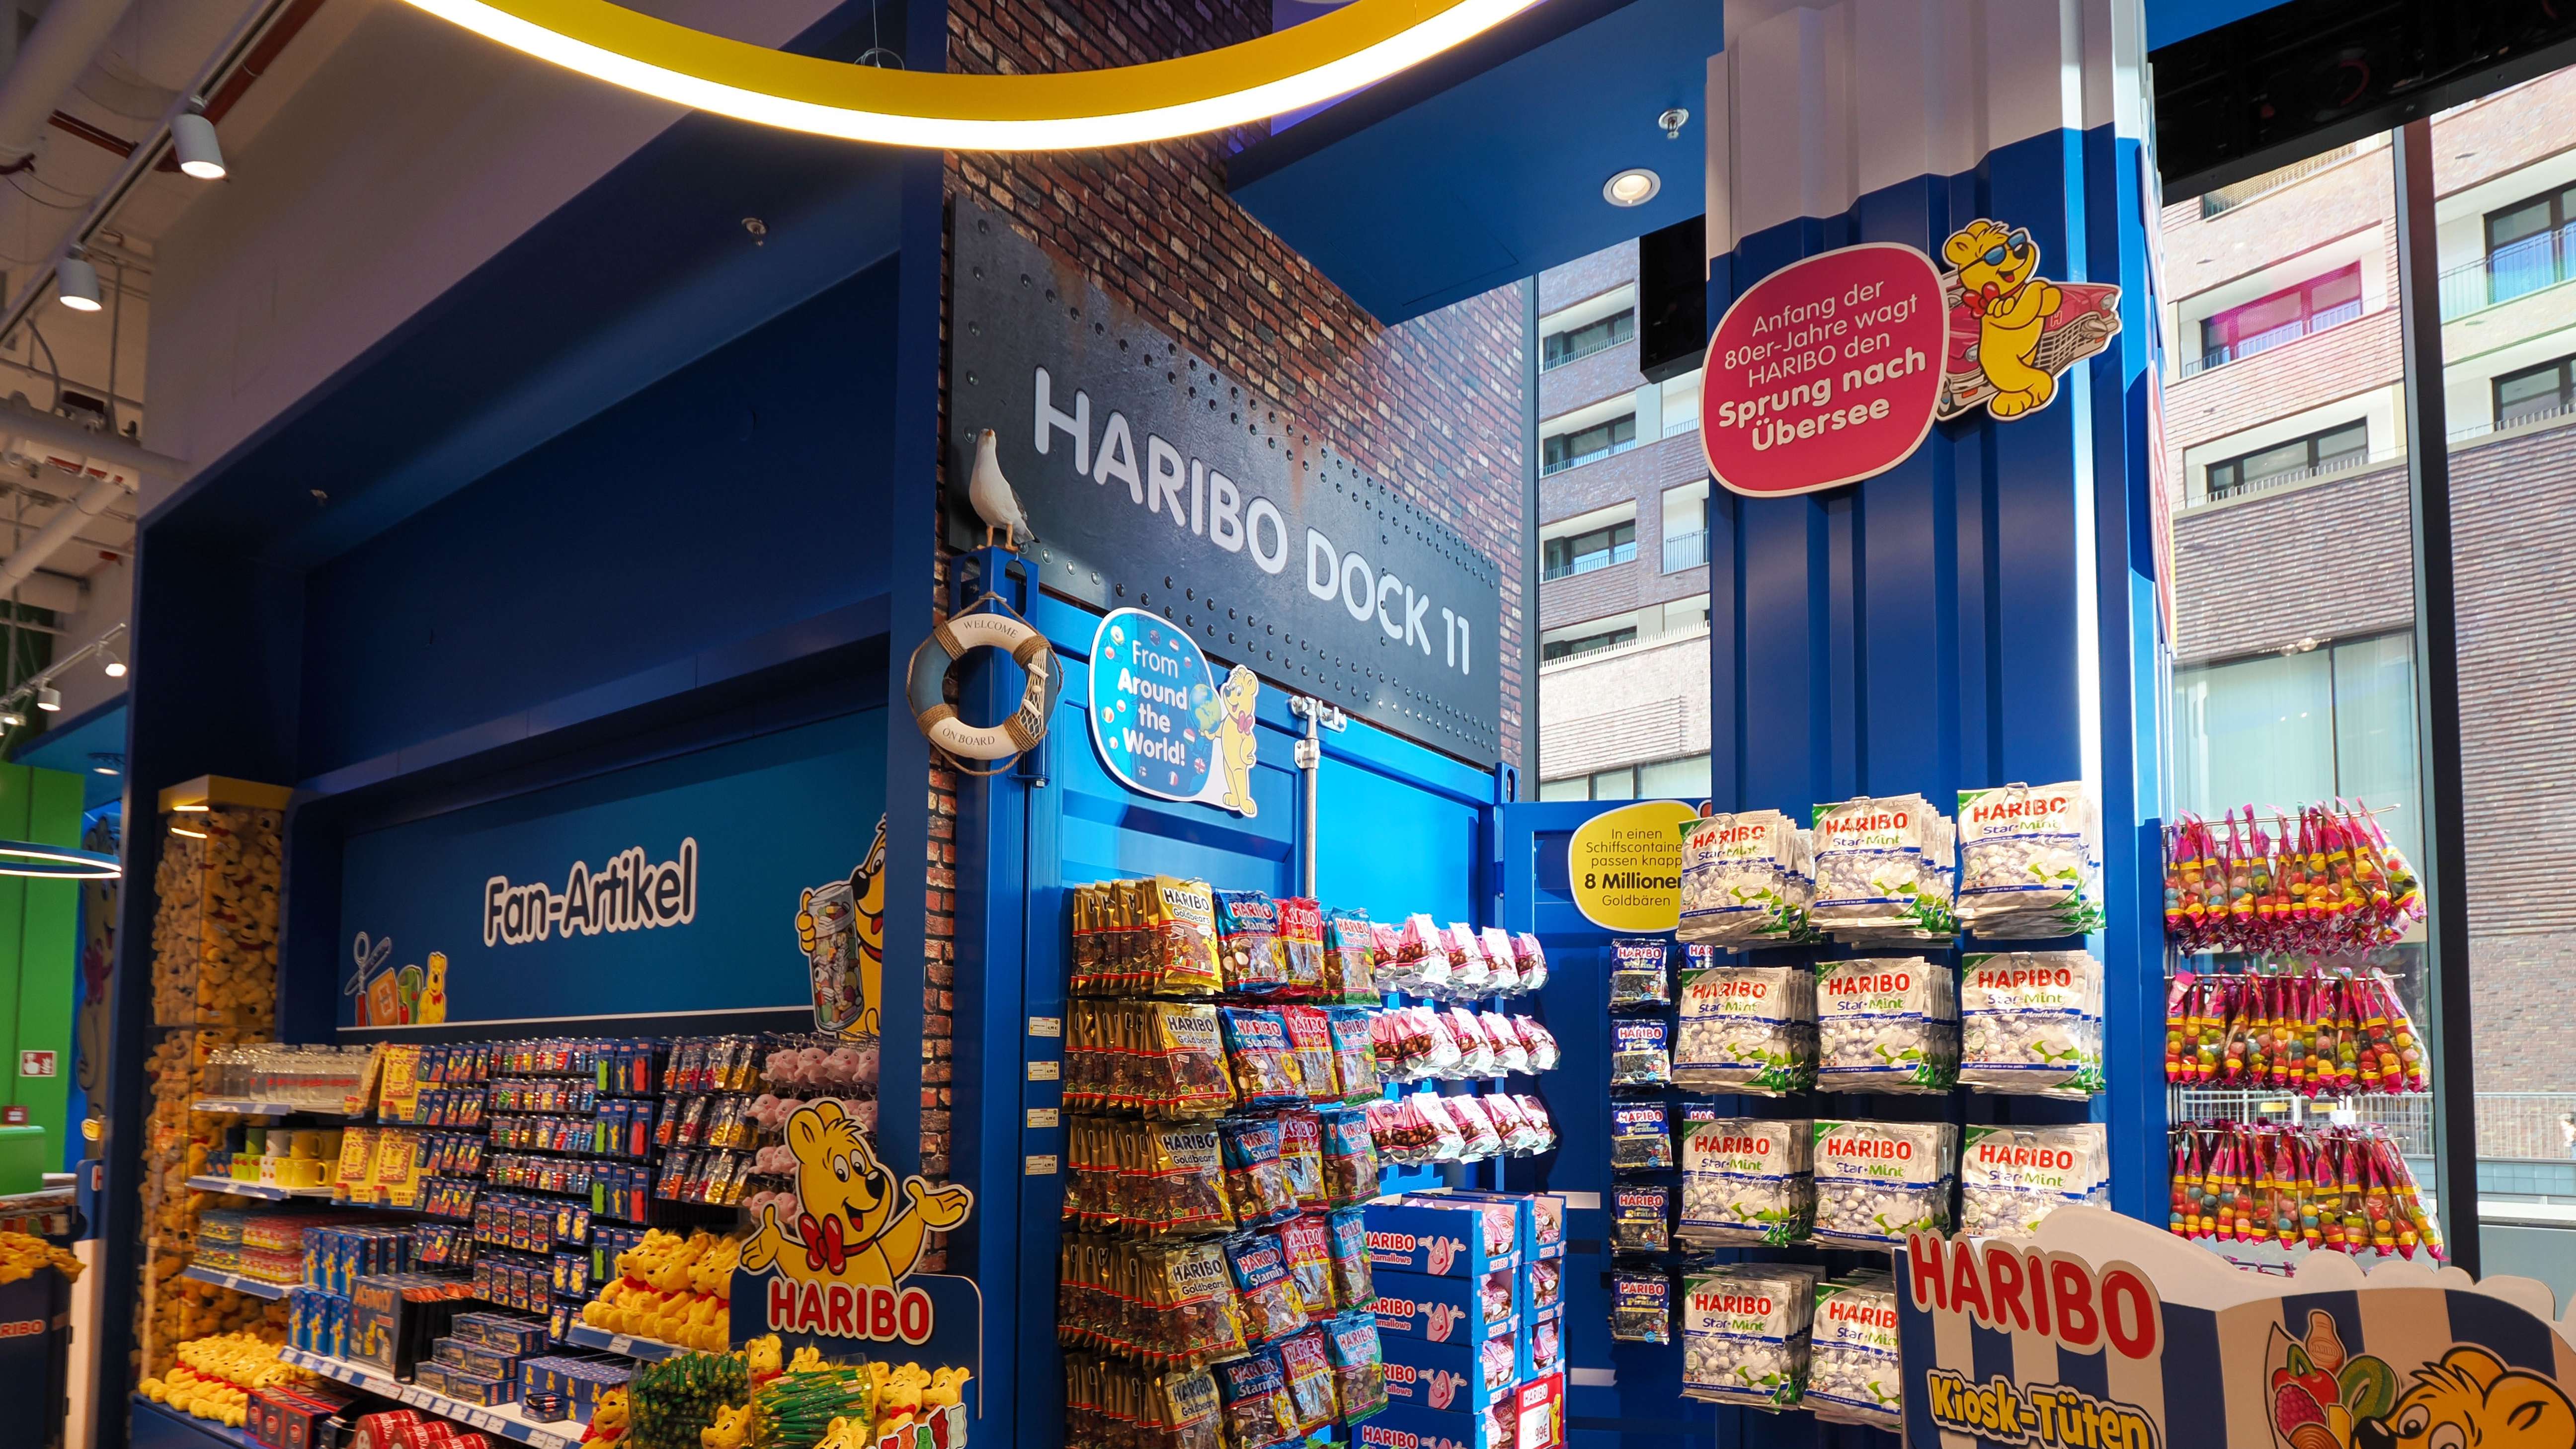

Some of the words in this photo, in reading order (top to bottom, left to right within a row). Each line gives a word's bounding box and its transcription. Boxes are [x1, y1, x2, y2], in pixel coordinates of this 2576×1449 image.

[1752, 295, 1835, 336] Anfang
[1844, 280, 1883, 307] der
[1725, 321, 1847, 370] 80er-Jahre
[1855, 295, 1917, 328] wagt
[1748, 345, 1836, 388] HARIBO
[1844, 332, 1890, 358] den
[1719, 378, 1831, 429] Sprung
[1843, 347, 1926, 393] nach
[1752, 398, 1889, 450] Übersee
[1035, 366, 1288, 574] HARIBO
[1306, 527, 1431, 655] DOCK
[1442, 606, 1469, 676] 11
[964, 620, 1018, 639] WELCOME
[1132, 640, 1178, 678] From
[1118, 668, 1187, 710] Around
[1138, 703, 1170, 733] the
[943, 727, 958, 740] ON
[959, 736, 995, 746] BOARD
[1123, 727, 1185, 766] World!
[1974, 798, 2067, 822] HARIBO
[1827, 812, 1908, 835] HARIBO
[1611, 829, 1622, 839] In
[1626, 829, 1662, 839] einen
[1586, 842, 1682, 853] Schiffscontaine
[1592, 857, 1637, 868] passen
[1642, 856, 1682, 868] knapp
[1585, 873, 1596, 889] 8
[487, 844, 692, 941] Fan-Artikel
[1163, 888, 1209, 911] HARIBO
[1602, 894, 1670, 906] Goldbären
[1174, 908, 1210, 924] Goldbears
[1231, 903, 1273, 918] HARIBO
[1242, 920, 1275, 931] Starmix
[1336, 919, 1369, 934] HARIBO
[1618, 947, 1662, 959] HARIBO
[1690, 945, 1713, 956] HAR
[1829, 973, 1910, 995] HARIBO
[1978, 968, 2071, 988] HARIBO
[1692, 982, 1767, 998] HARIBO
[1167, 1017, 1214, 1032] HARIBO
[1236, 1020, 1282, 1036] HARIBO
[1334, 1020, 1368, 1035] HARIBO
[1178, 1035, 1217, 1044] Goldbears
[1246, 1037, 1284, 1047] Starmix
[1619, 1029, 1663, 1039] HARIBO
[1619, 1111, 1663, 1123] HARIBO
[1163, 1134, 1214, 1151] HARIBO
[1694, 1136, 1770, 1155] HARIBO
[1828, 1138, 1912, 1160] HARIBO
[1174, 1155, 1216, 1165] Goldbears
[1253, 1149, 1277, 1161] Starm
[1980, 1144, 2073, 1170] HARIBO
[1620, 1196, 1663, 1206] HARIBO
[1238, 1248, 1280, 1274] HARIBO
[1369, 1253, 1411, 1264] hamallows
[1540, 1247, 1555, 1257] HARIBO
[1173, 1260, 1223, 1282] HARIBO
[1491, 1259, 1508, 1271] HARIBO
[1250, 1266, 1285, 1285] Starmix
[1182, 1281, 1225, 1295] Goldbears
[1620, 1283, 1664, 1295] HARIBO
[1910, 1233, 2157, 1360] HARIBO
[770, 1280, 930, 1341] HARIBO
[1695, 1293, 1771, 1315] HARIBO
[1539, 1309, 1553, 1320] HARIBO
[1829, 1302, 1898, 1328] HARIB
[0, 1320, 42, 1337] RIBO
[1375, 1319, 1410, 1329] amallows
[1489, 1323, 1506, 1336] HARIBO
[1338, 1326, 1375, 1349] HARIBO
[1228, 1358, 1278, 1384] HARIBO
[1382, 1365, 1415, 1383] RIBO
[1173, 1376, 1212, 1402] HARIBO
[1239, 1375, 1283, 1397] Starmix
[1387, 1385, 1412, 1396] allows
[1525, 1386, 1547, 1402] HARIBO
[1182, 1399, 1216, 1417] Goldbears
[1930, 1374, 2149, 1449] Kiosk-Tüten
[1363, 1426, 1417, 1449] HARIBO
